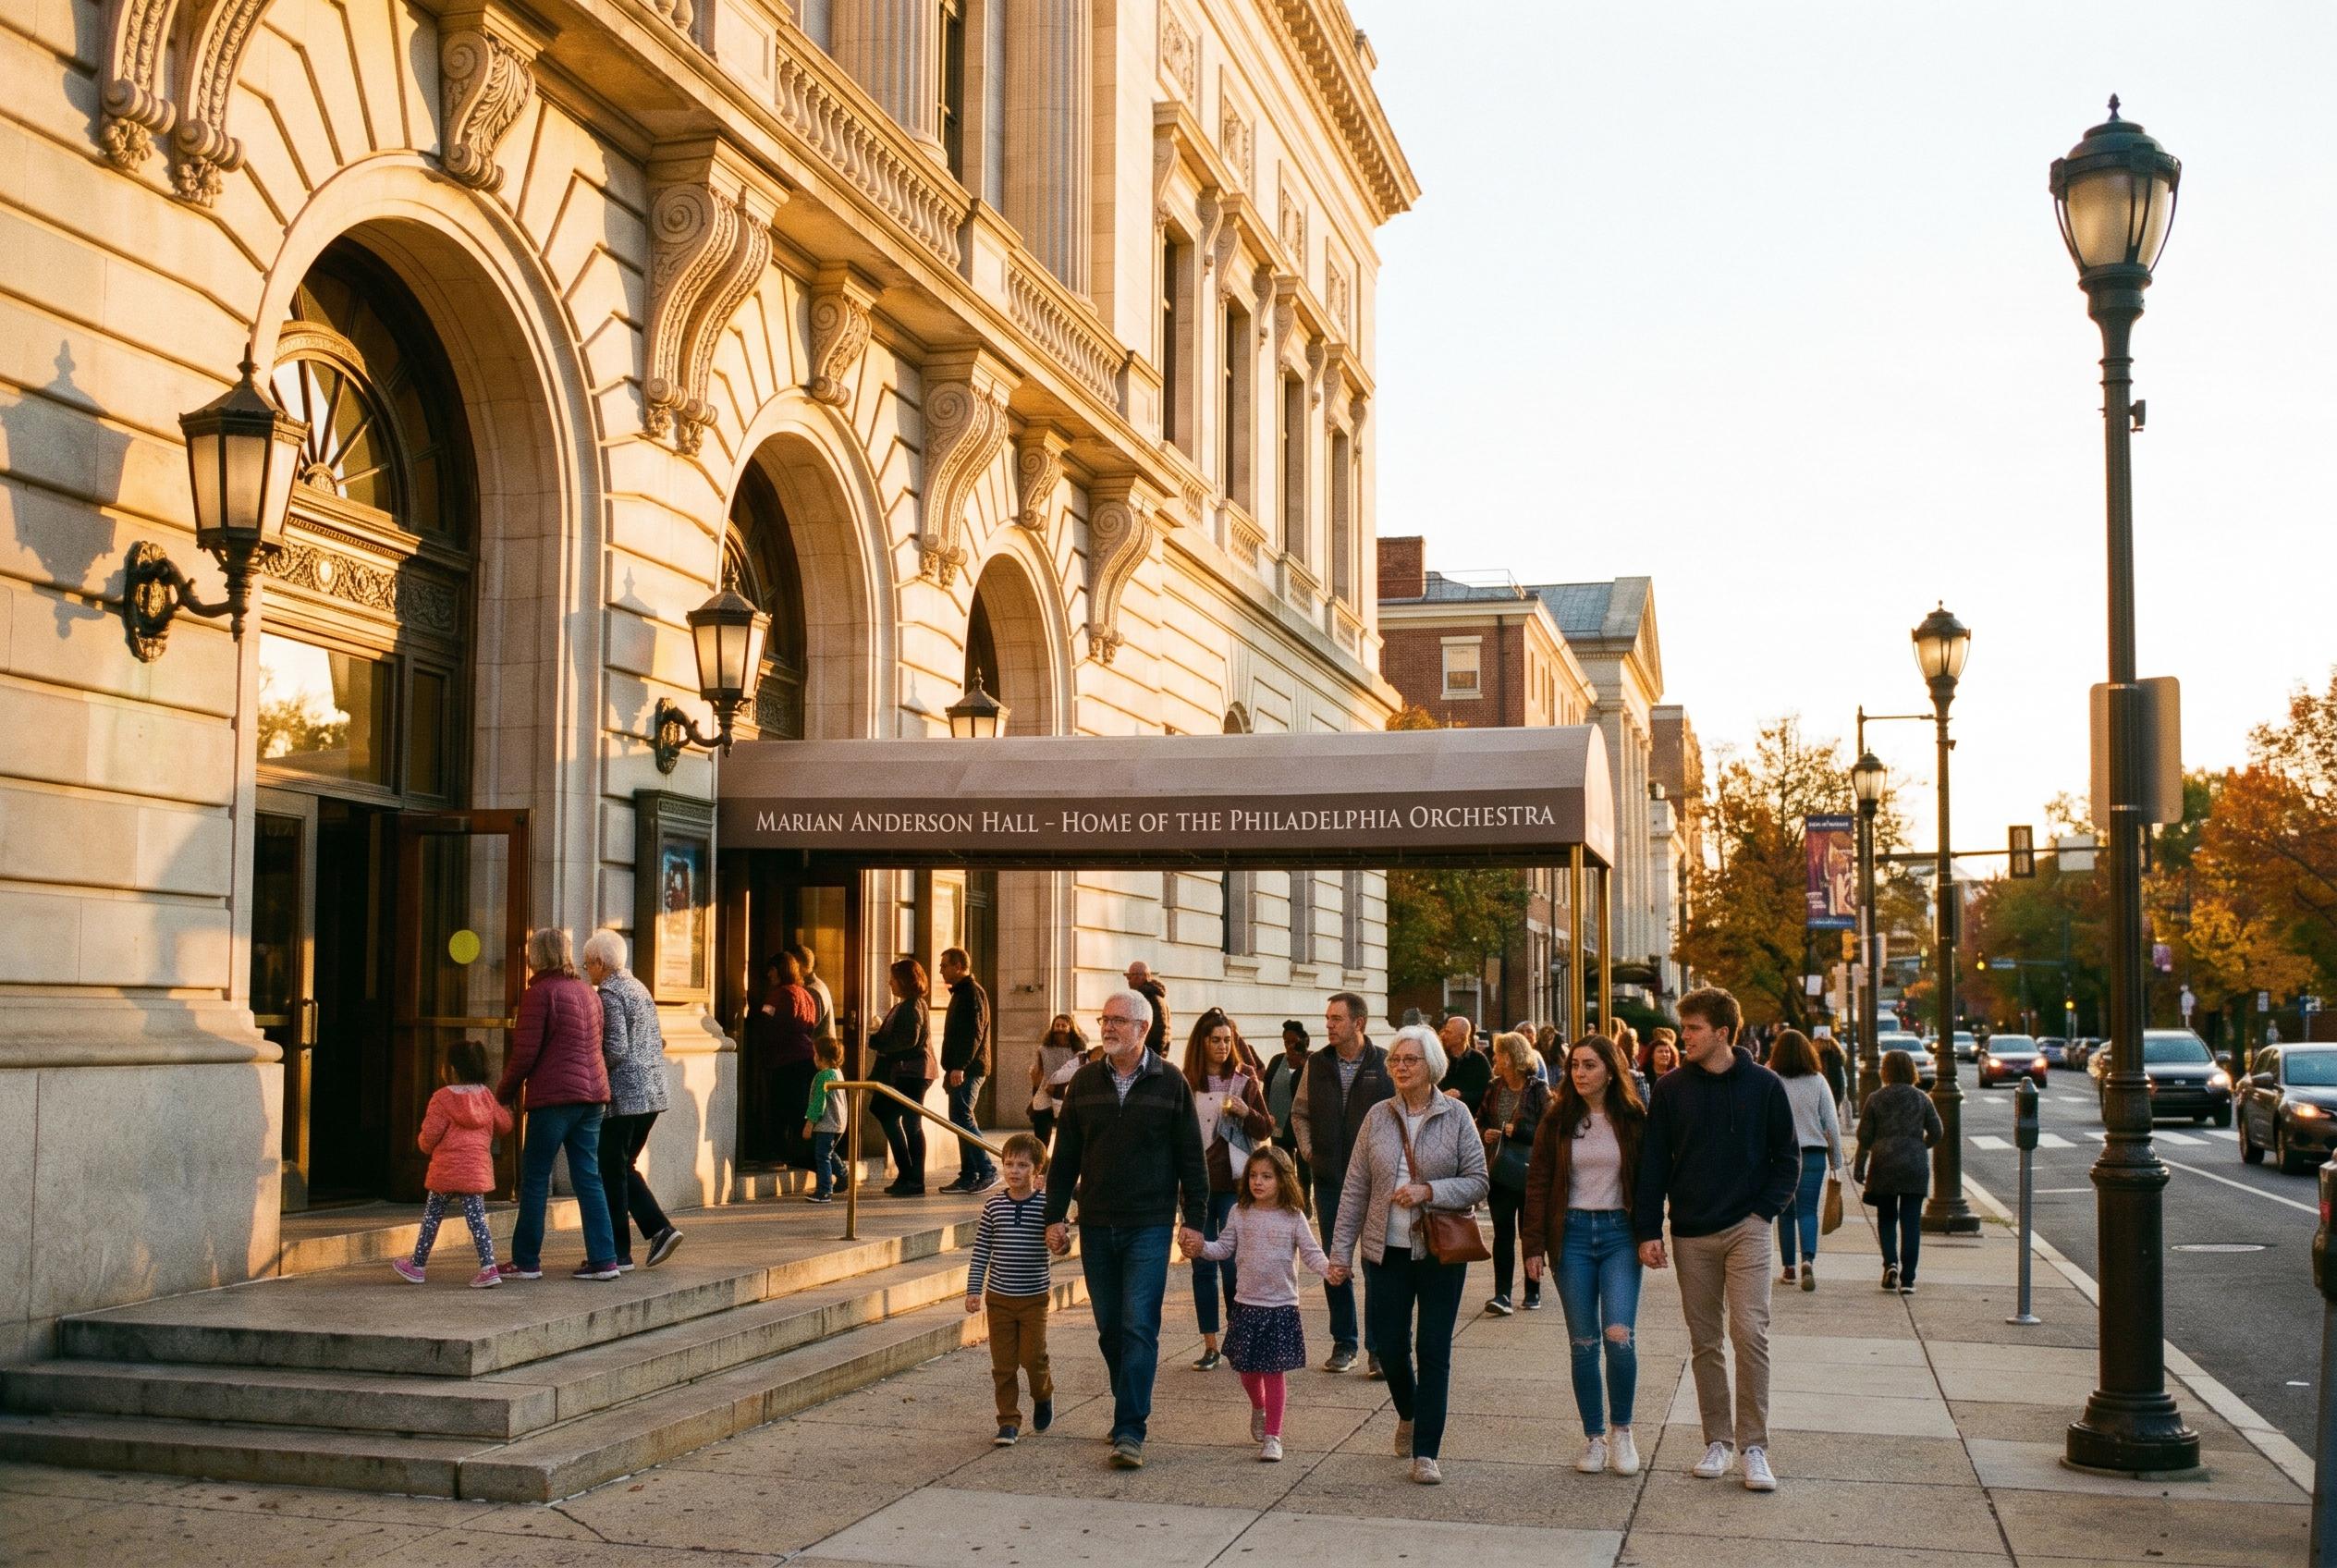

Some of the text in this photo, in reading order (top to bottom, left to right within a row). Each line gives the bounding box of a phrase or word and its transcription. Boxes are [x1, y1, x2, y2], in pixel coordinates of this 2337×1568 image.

[756, 811, 843, 832] MARIAN
[850, 811, 973, 832] ANDERSON
[982, 811, 1039, 832] HALL
[1061, 811, 1132, 832] HOME
[1138, 813, 1168, 832] OF
[1175, 812, 1222, 832] THE
[1230, 808, 1403, 831] PHILADELPHIA
[1410, 805, 1556, 828] ORCHESTRA
